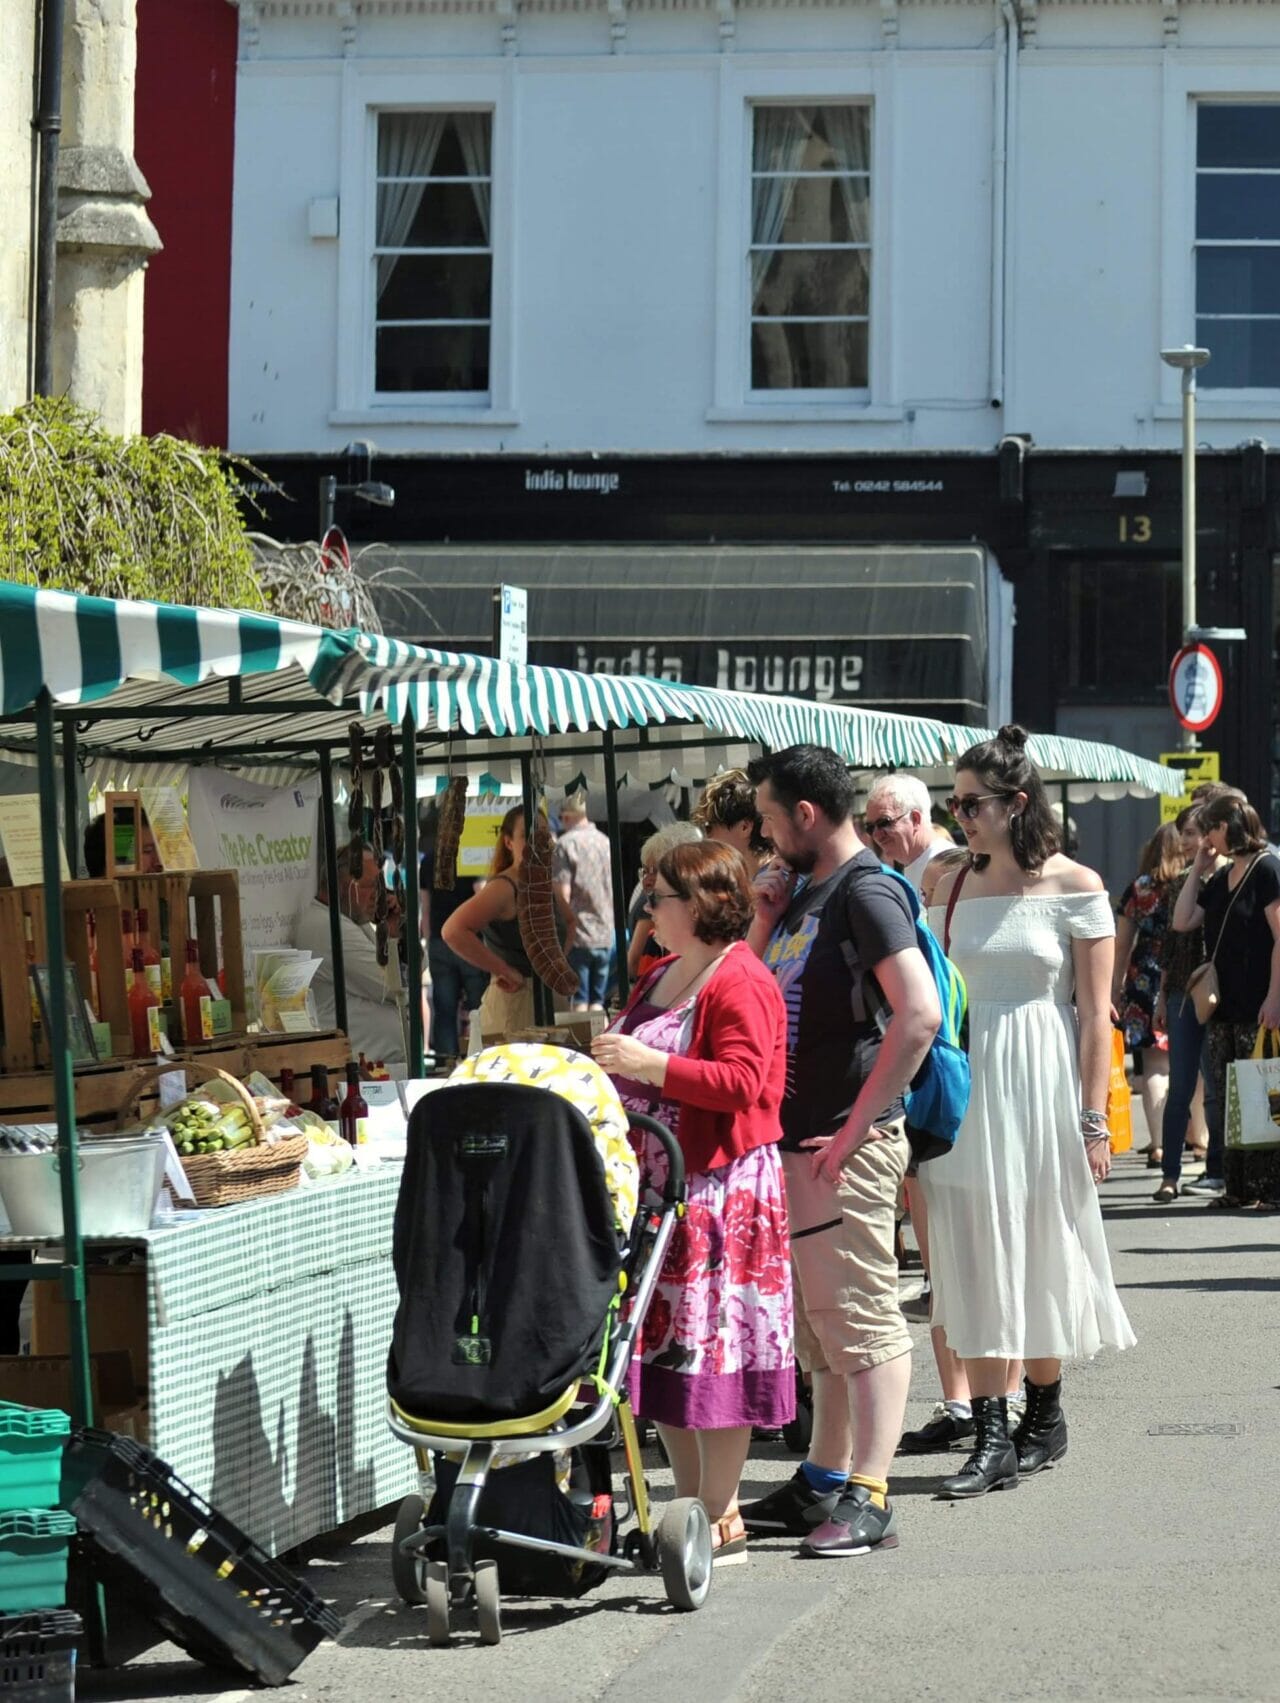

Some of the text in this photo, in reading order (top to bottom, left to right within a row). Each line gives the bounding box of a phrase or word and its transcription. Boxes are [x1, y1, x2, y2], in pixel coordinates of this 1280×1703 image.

[525, 469, 619, 494] india lounge
[1118, 515, 1152, 542] 13
[715, 649, 864, 701] lounge
